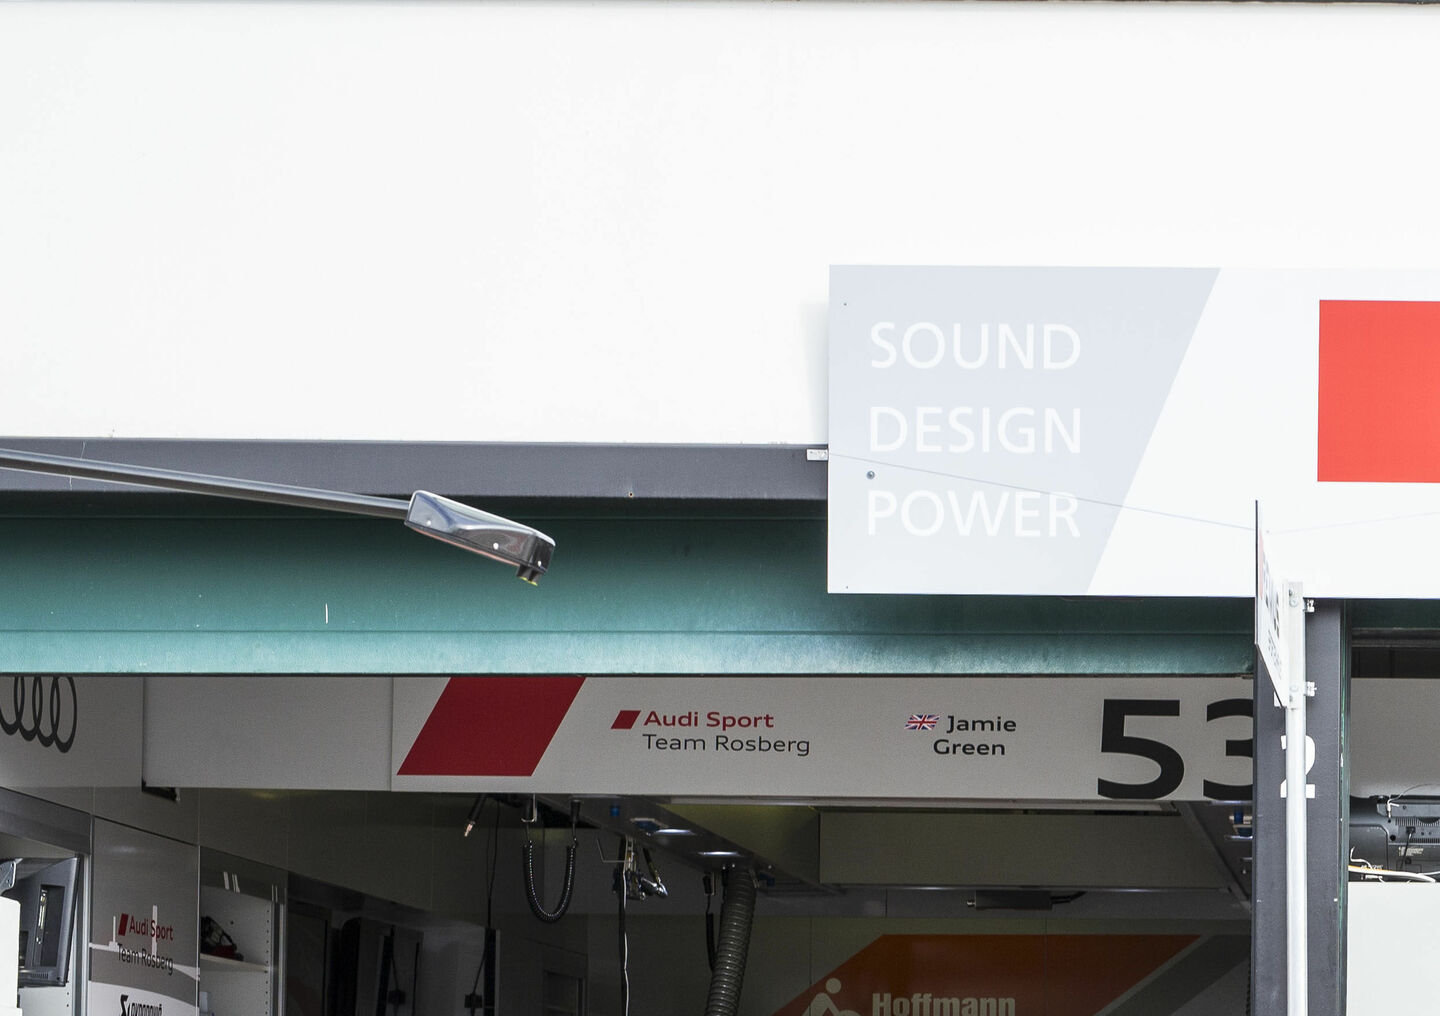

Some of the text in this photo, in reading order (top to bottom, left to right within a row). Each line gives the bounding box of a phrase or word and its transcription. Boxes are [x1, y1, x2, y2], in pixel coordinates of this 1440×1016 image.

[870, 320, 1082, 370] SOUND
[868, 406, 1082, 454] DESIGN
[866, 489, 1082, 539] POWER
[643, 710, 775, 733] Audi Sport
[945, 714, 1017, 734] Jamie
[642, 733, 811, 757] Team Rosberg
[933, 738, 1006, 756] Green
[1098, 698, 1254, 800] 53
[129, 915, 174, 943] Audi Sport
[117, 942, 174, 976] Team Rosberg
